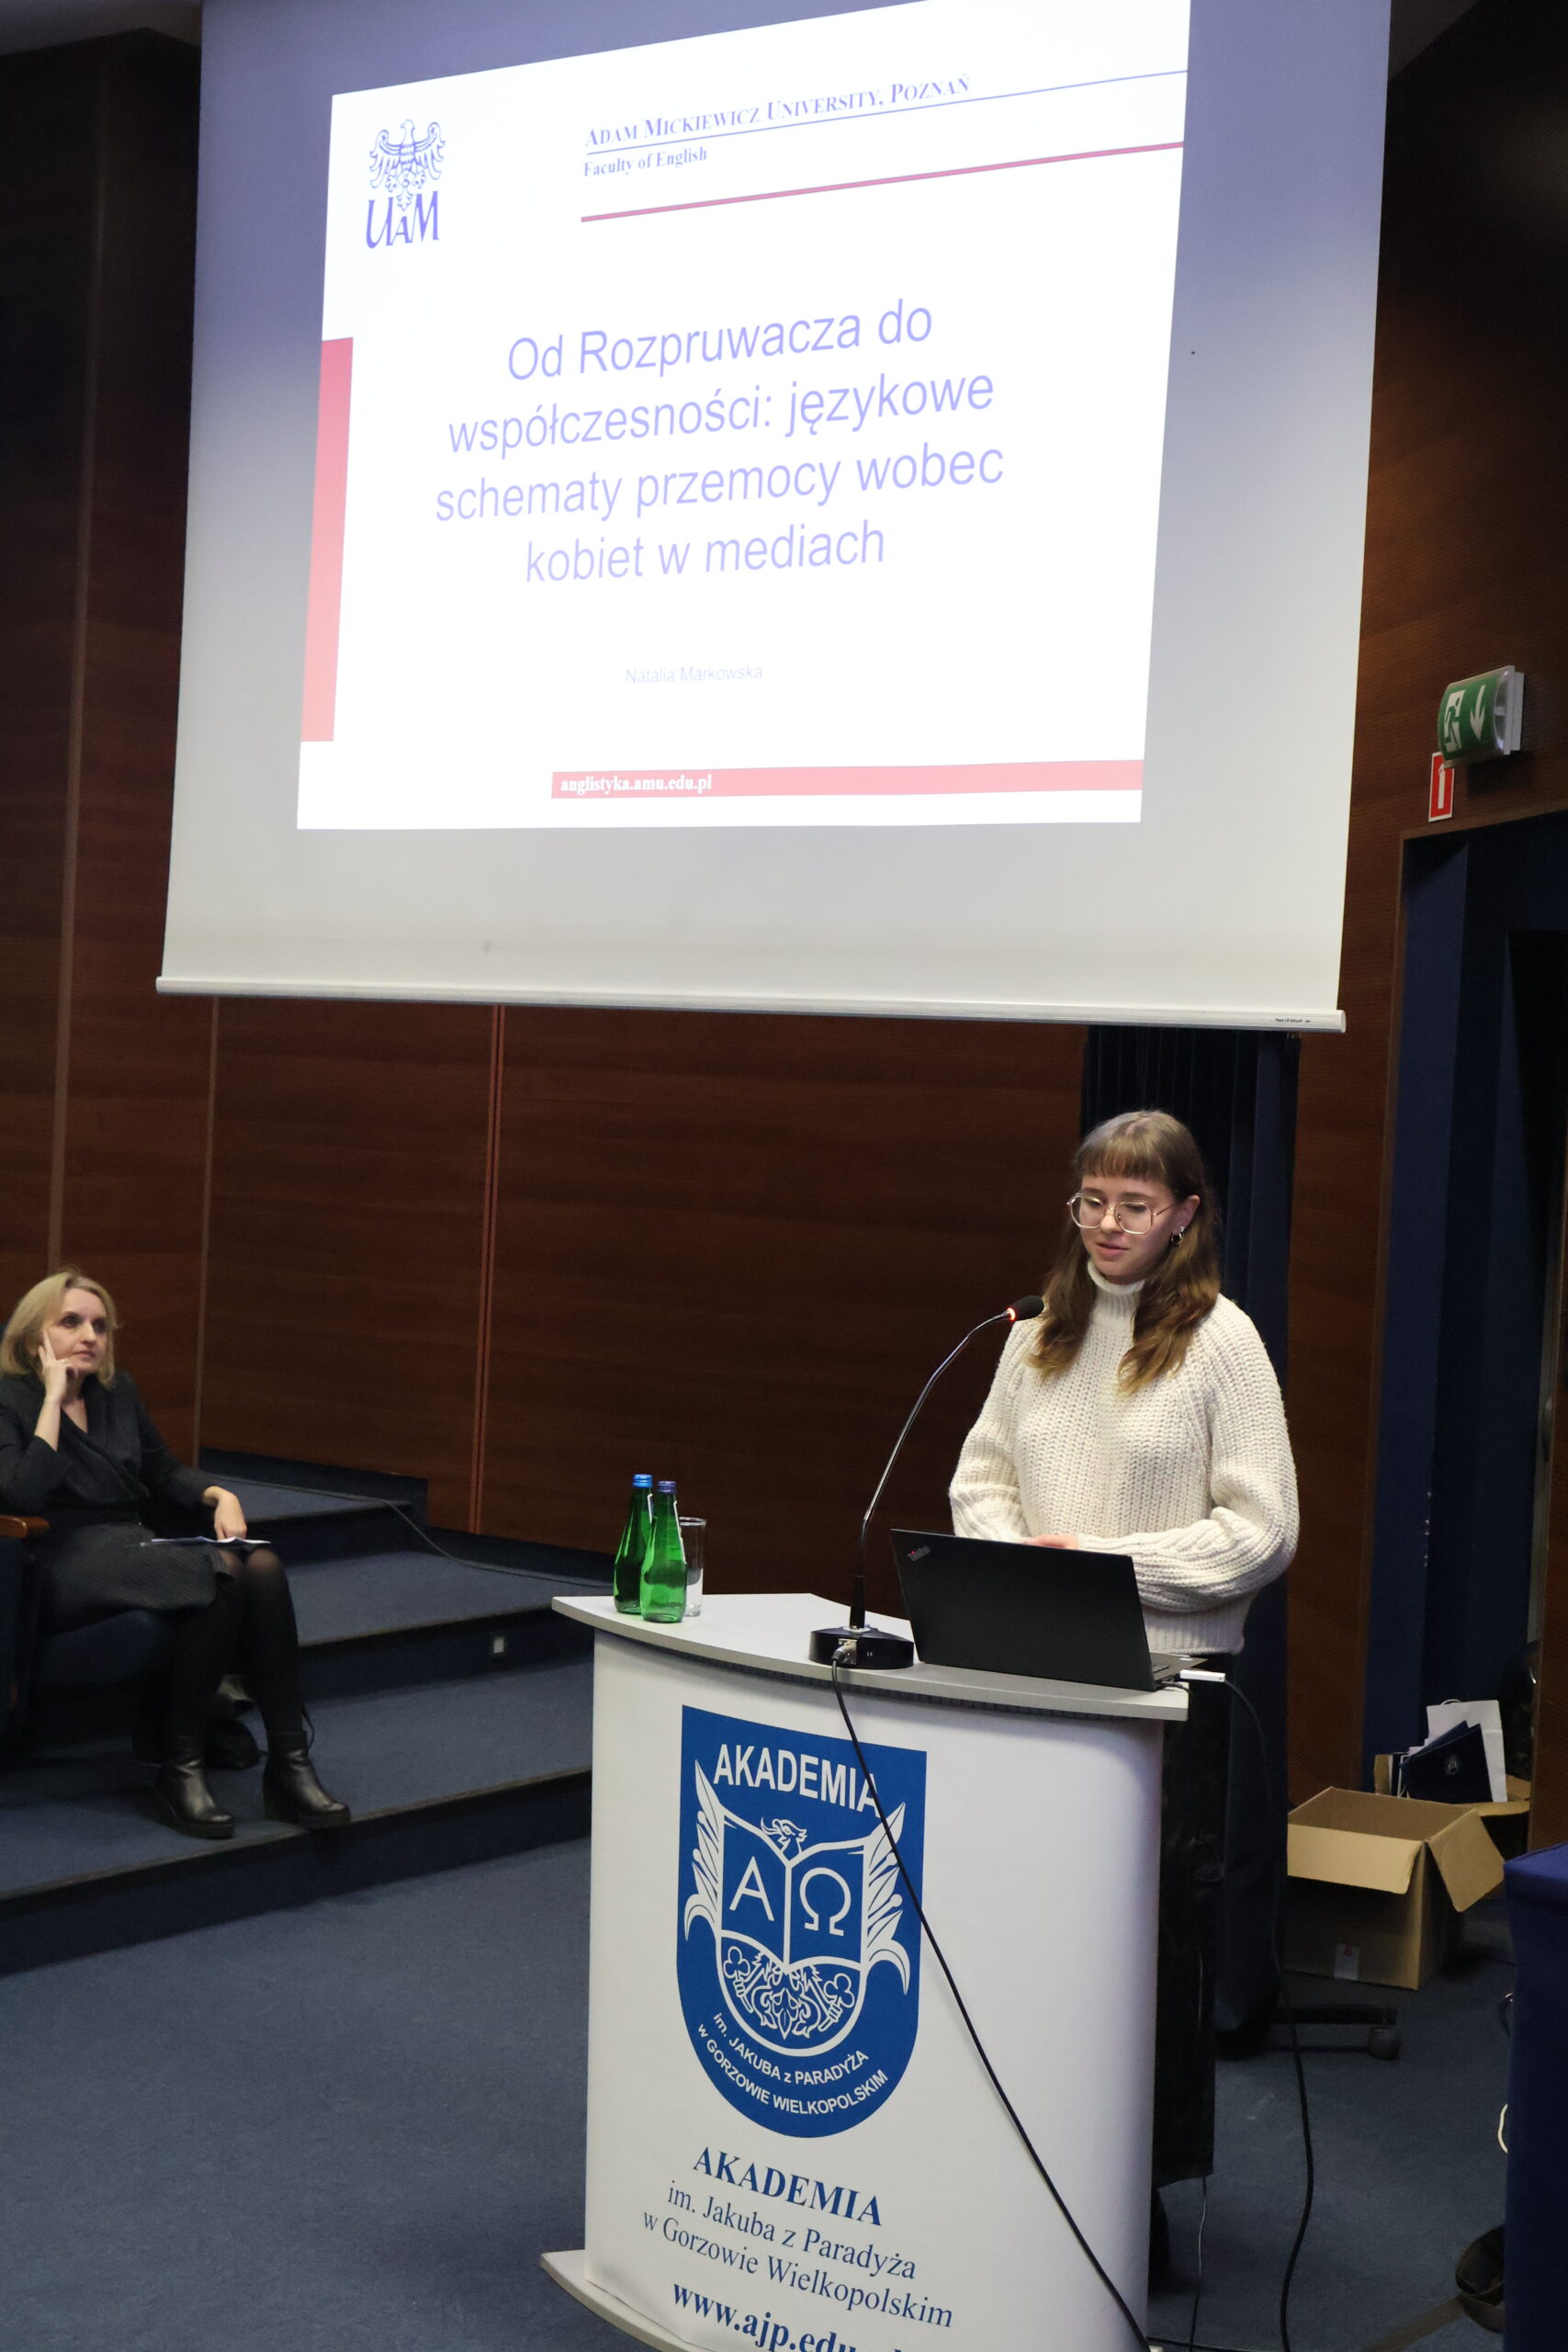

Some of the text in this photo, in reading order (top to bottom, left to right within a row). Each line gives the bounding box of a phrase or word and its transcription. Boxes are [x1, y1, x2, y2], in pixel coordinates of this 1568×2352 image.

[585, 74, 971, 148] ADAM MICKIEWICZ UNIVERSITY, POZNAŃ
[583, 147, 707, 177] Faculty of English
[367, 190, 439, 249] UAM
[507, 298, 932, 380] Od Rozpruwacza do
[448, 373, 994, 459] współczesności: językowe
[435, 442, 1004, 522] schematy przemocy wobec
[526, 519, 885, 582] kobiet w mediach
[626, 664, 763, 684] Natalia Markowska
[560, 774, 713, 796] anglistyka.amu.edu.pl
[713, 1744, 881, 1818] AKADEMIA
[697, 2024, 889, 2115] w GORZOWIE WIELKOPOLSKIM
[713, 2012, 869, 2086] im. JAKUBA z PARADYŻA
[693, 2146, 882, 2226] AKADEMIA
[667, 2179, 916, 2279] im. Jakuba z Paradyża
[644, 2211, 953, 2328] w Gorzowie Wielkopolskim
